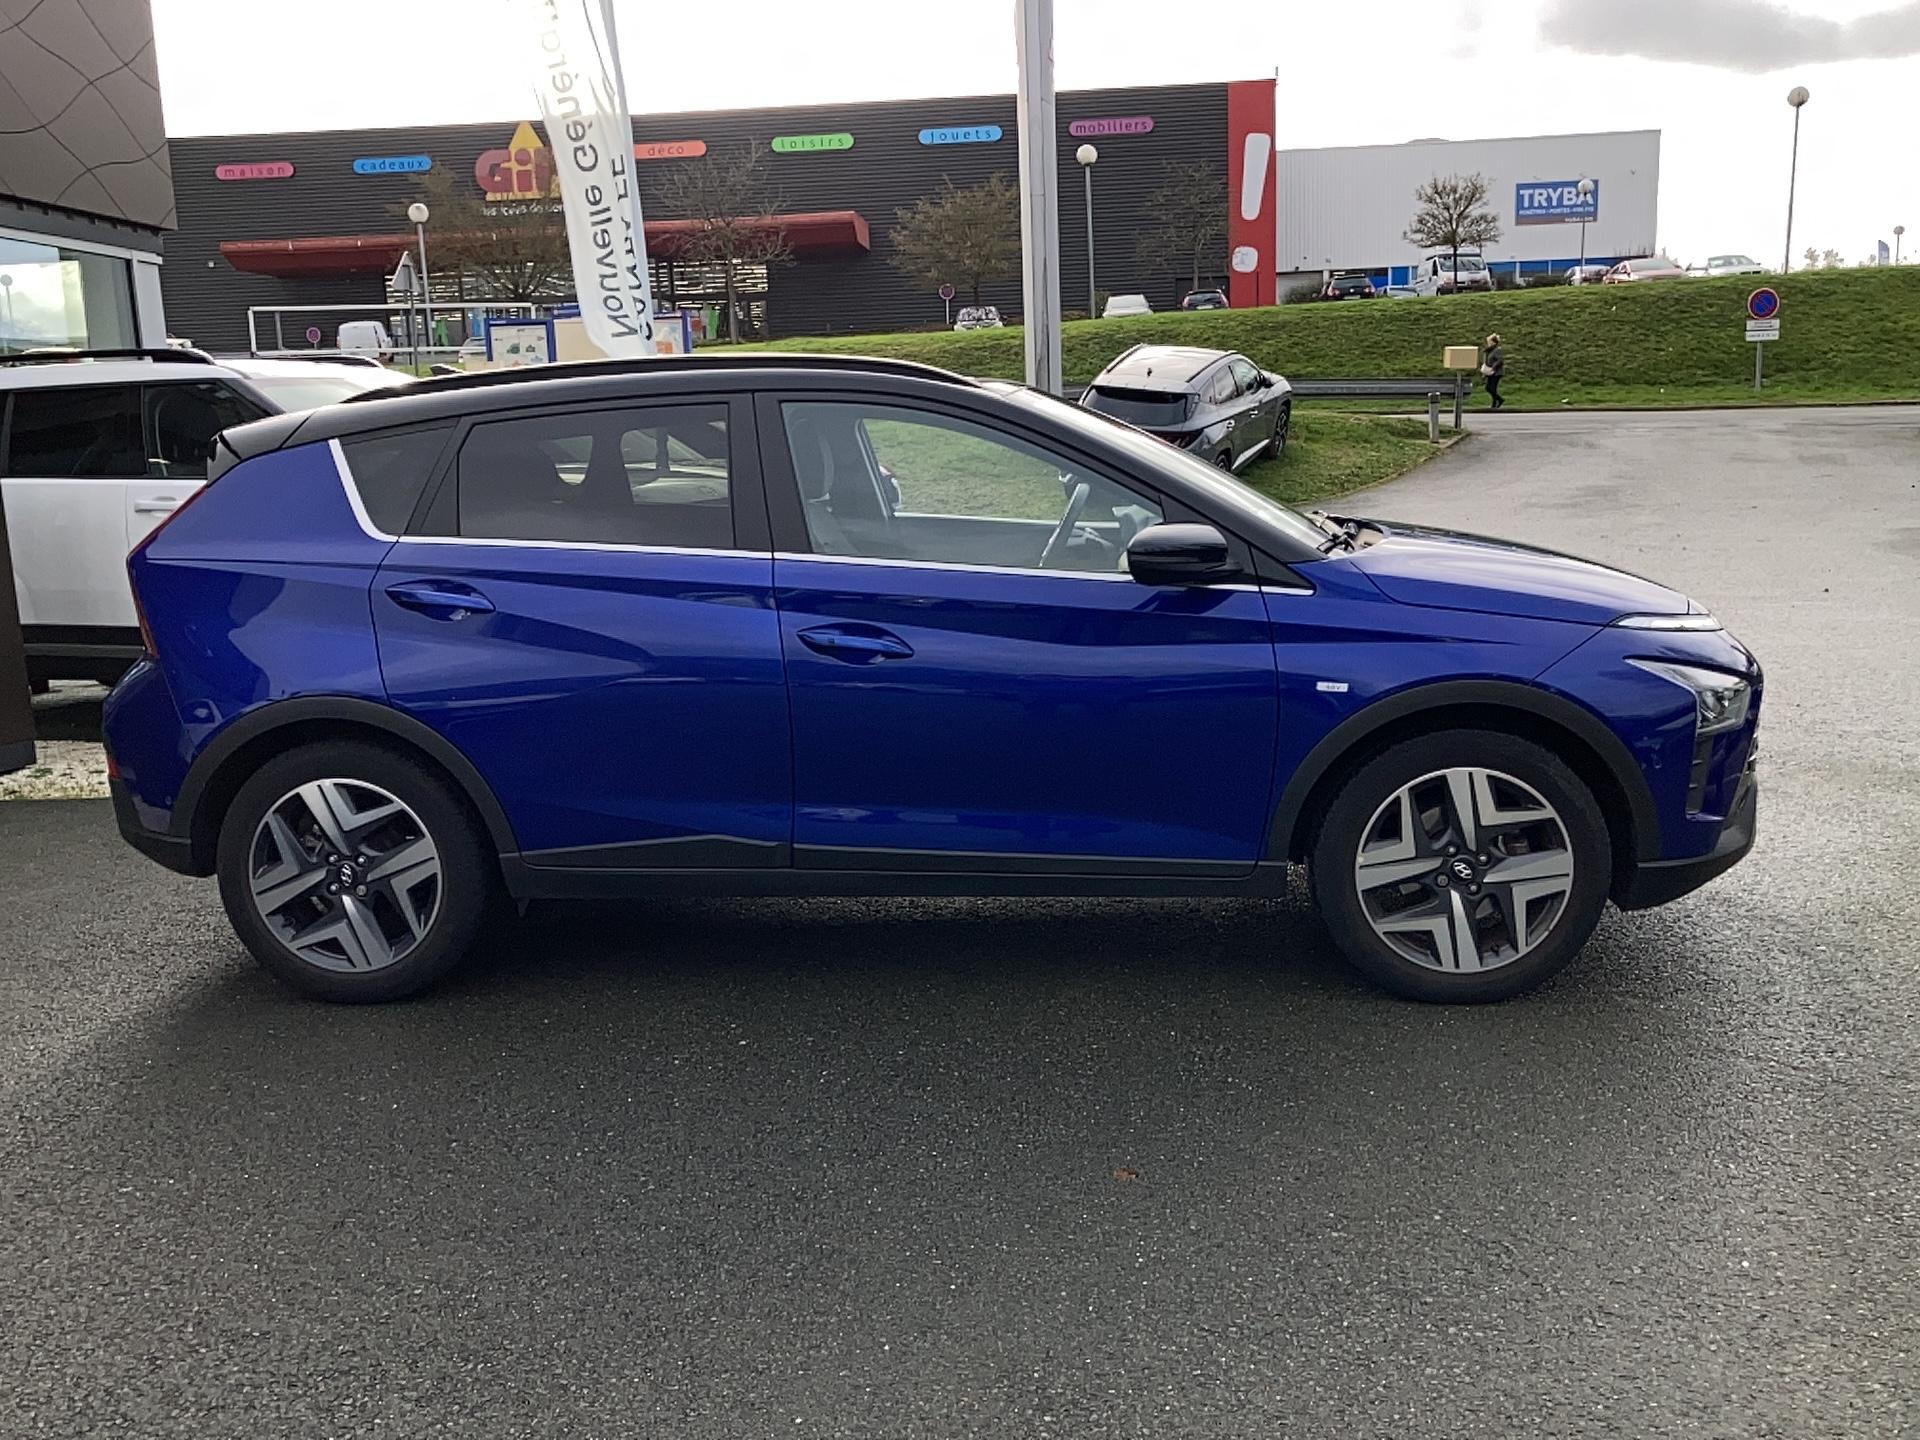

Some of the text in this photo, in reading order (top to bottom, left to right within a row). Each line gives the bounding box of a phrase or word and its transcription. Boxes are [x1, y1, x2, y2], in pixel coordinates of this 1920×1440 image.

[1075, 119, 1148, 134] mobiliers
[929, 128, 992, 143] jouets
[648, 144, 685, 156] déco
[781, 137, 845, 150] loisirs
[360, 157, 424, 171] cadeaux
[224, 165, 285, 178] maison
[1519, 186, 1594, 208] TRYBA
